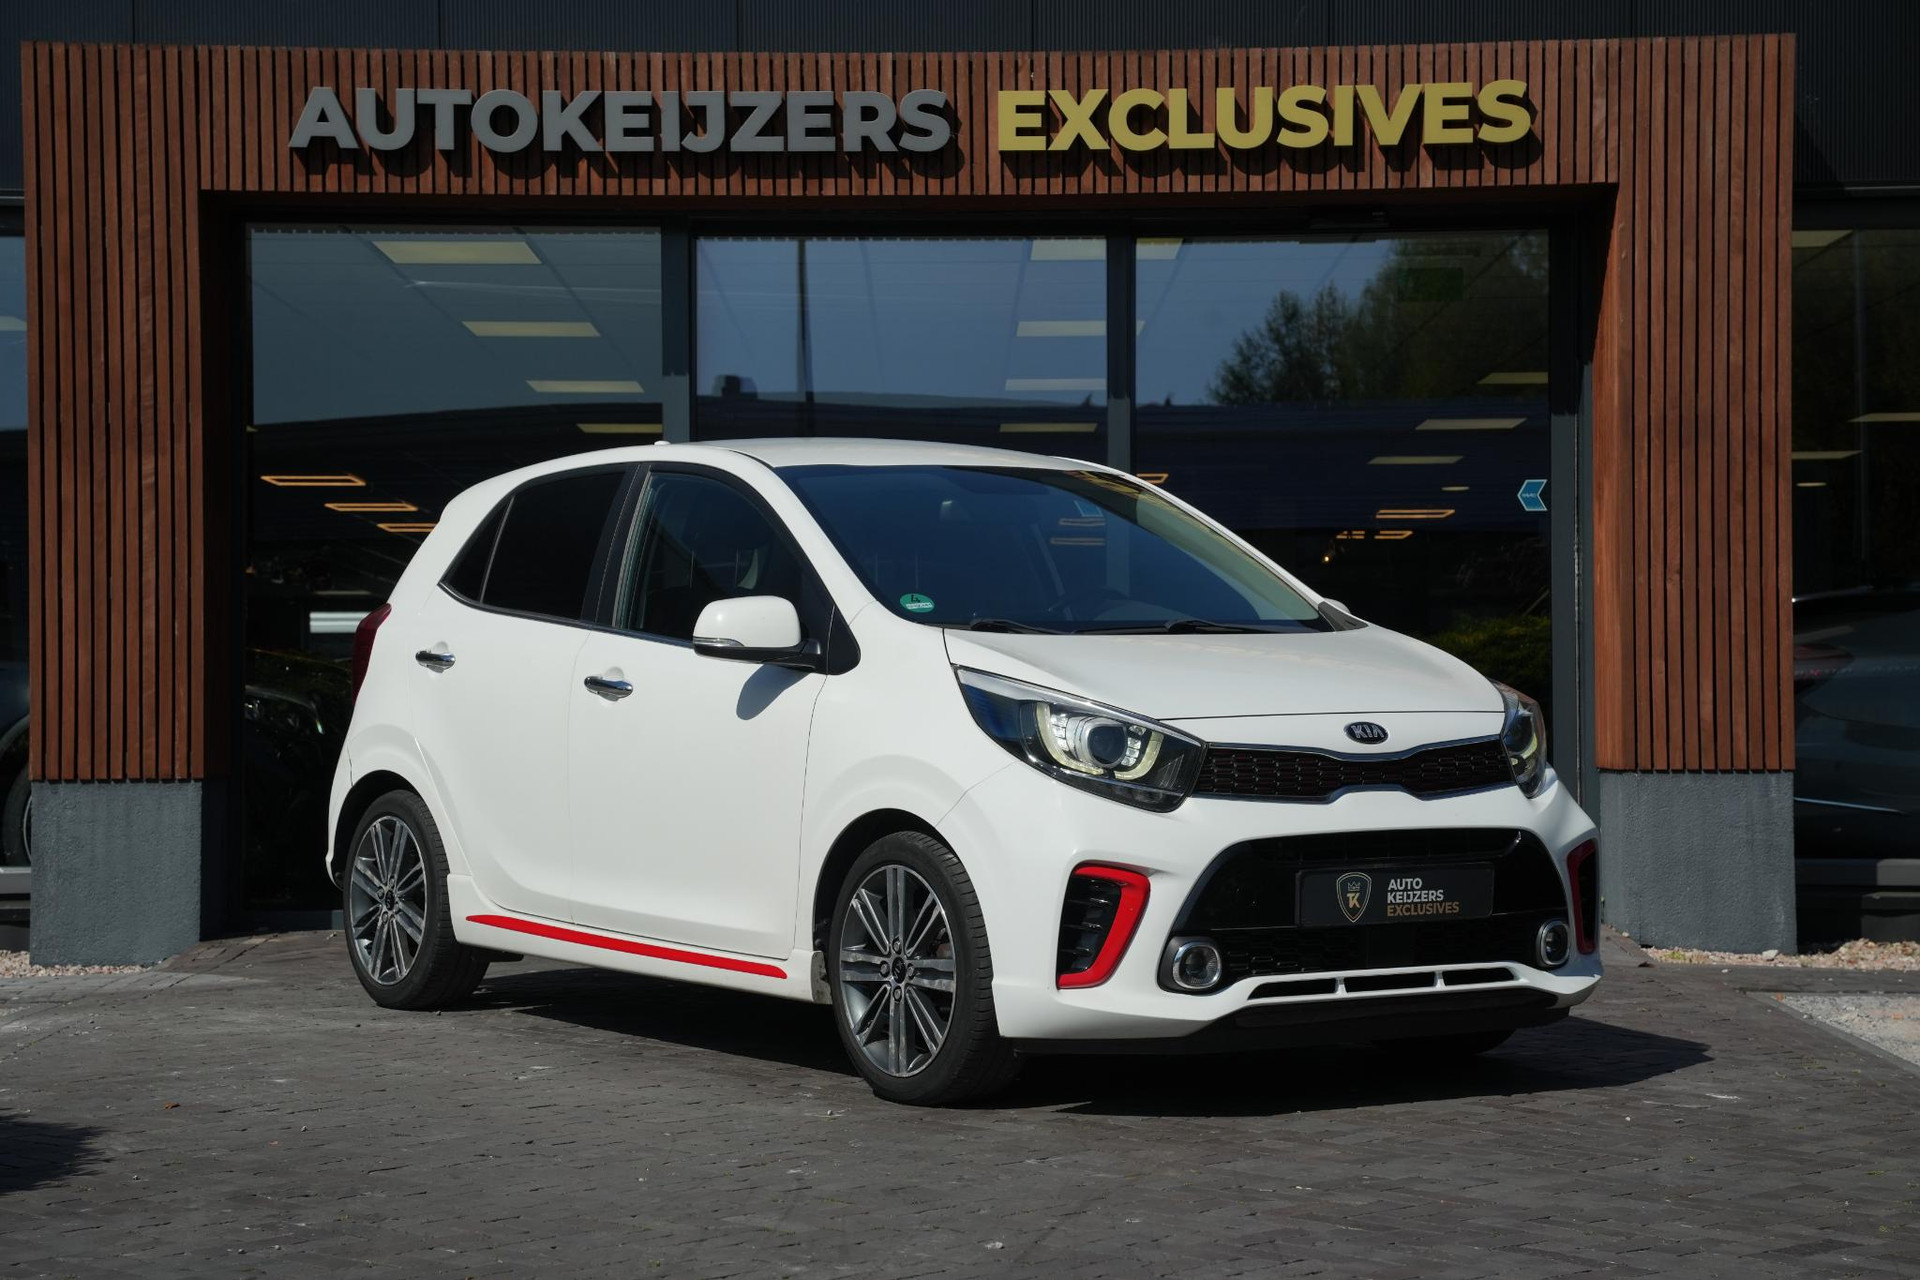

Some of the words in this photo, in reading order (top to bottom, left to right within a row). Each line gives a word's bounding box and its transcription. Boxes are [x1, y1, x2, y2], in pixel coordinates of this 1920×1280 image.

[289, 86, 953, 153] AUTOKEIJZERS
[998, 79, 1532, 152] EXCLUSIVES
[1350, 724, 1385, 739] KIA
[1388, 878, 1422, 890] AUTO
[1387, 889, 1444, 904] KEIJZERS
[1387, 901, 1460, 917] EXCLUSIVES
